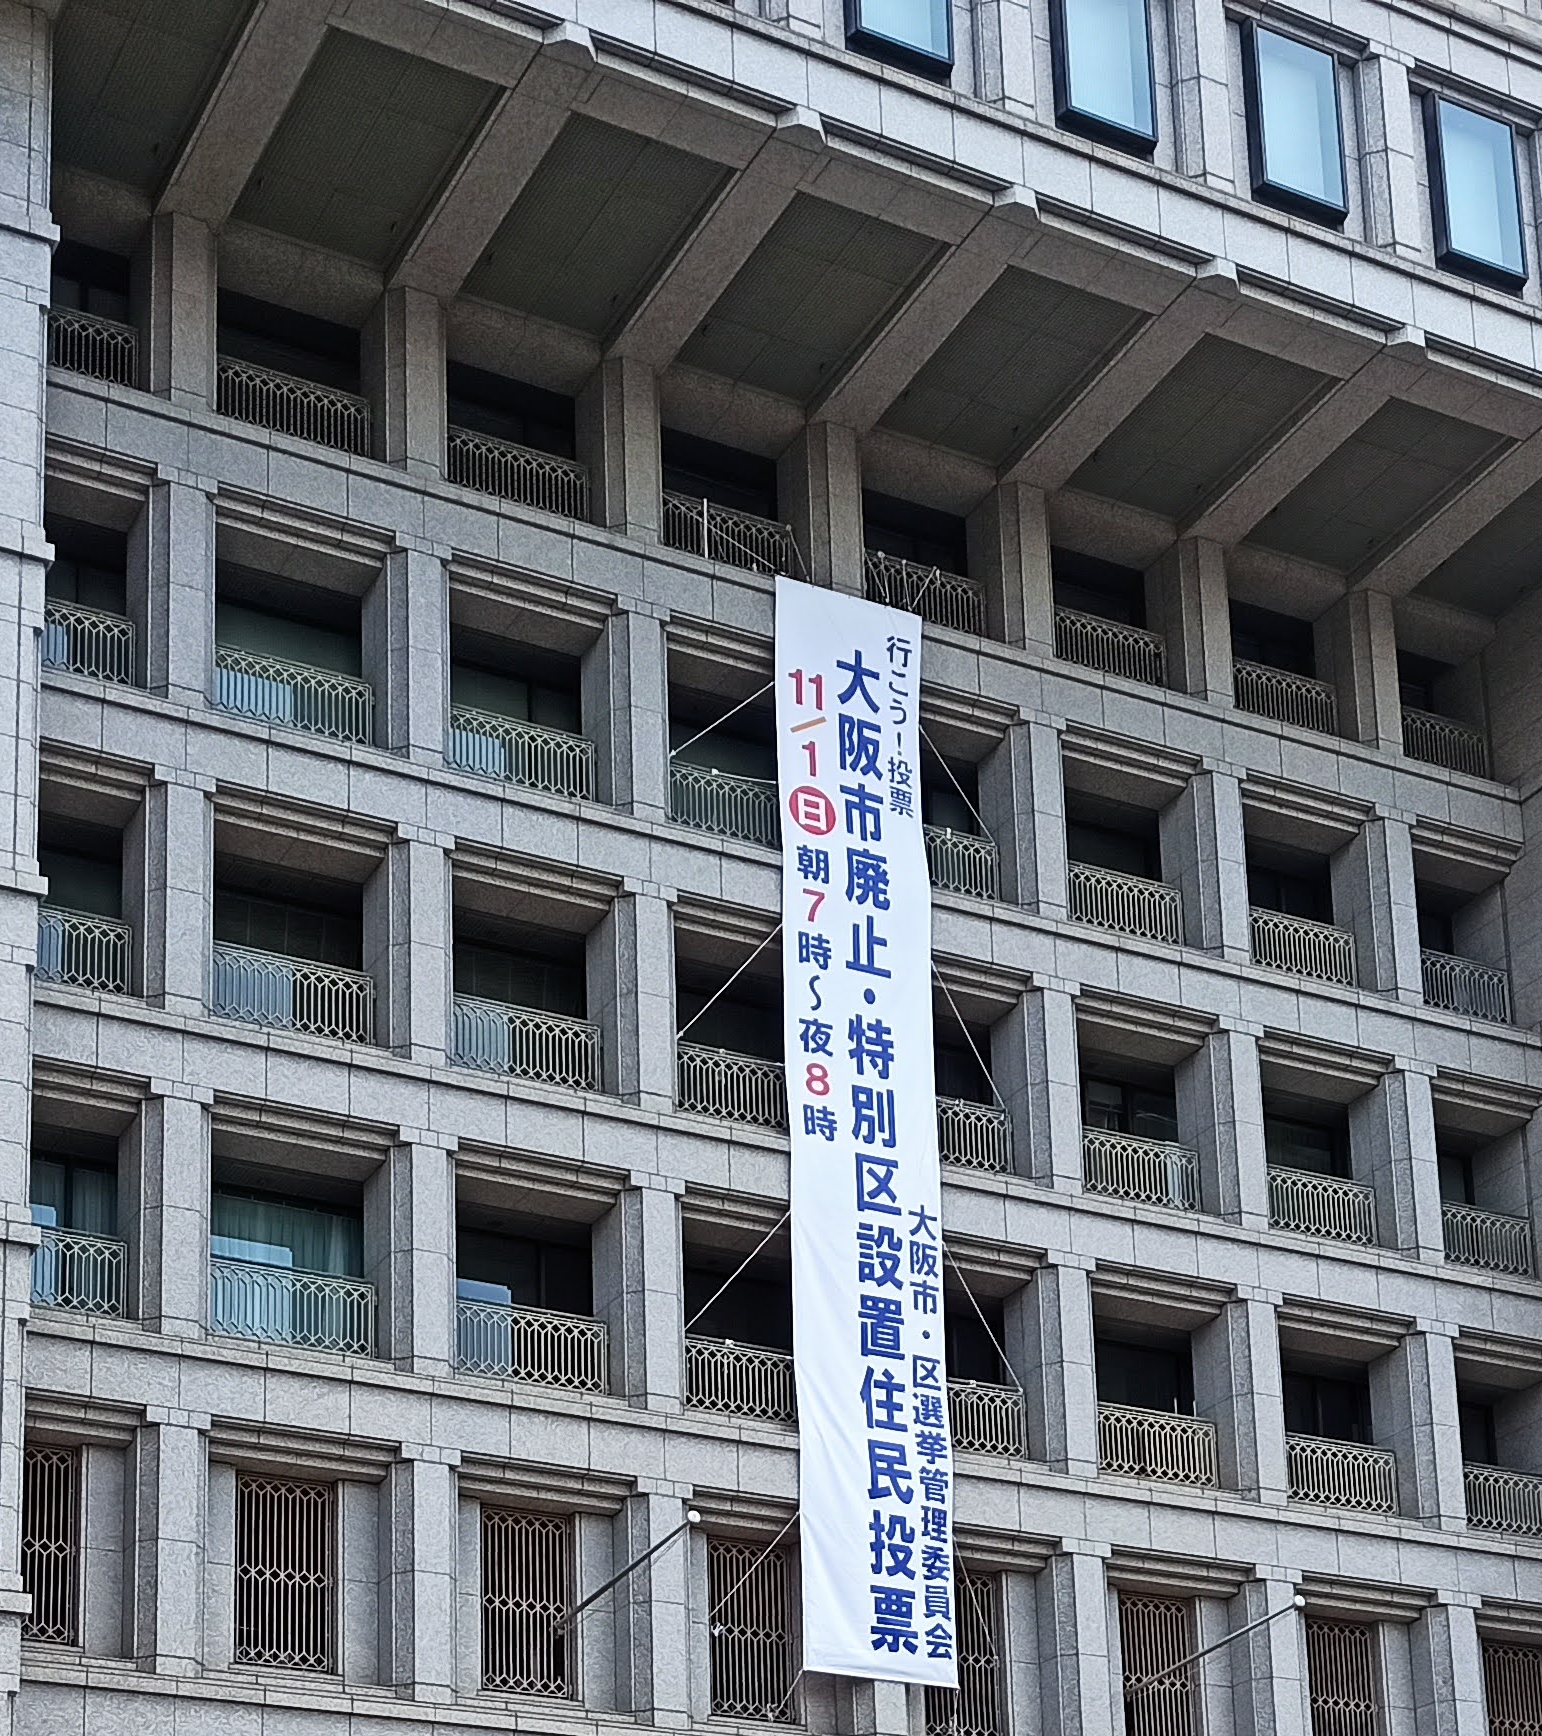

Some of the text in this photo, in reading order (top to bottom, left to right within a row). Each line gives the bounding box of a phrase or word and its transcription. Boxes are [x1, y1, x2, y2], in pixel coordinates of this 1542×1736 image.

[836, 649, 919, 1655] 大阪市廃止・特別区設置住民投票
[908, 1204, 953, 1661] 大阪市・区選挙管理委員会
